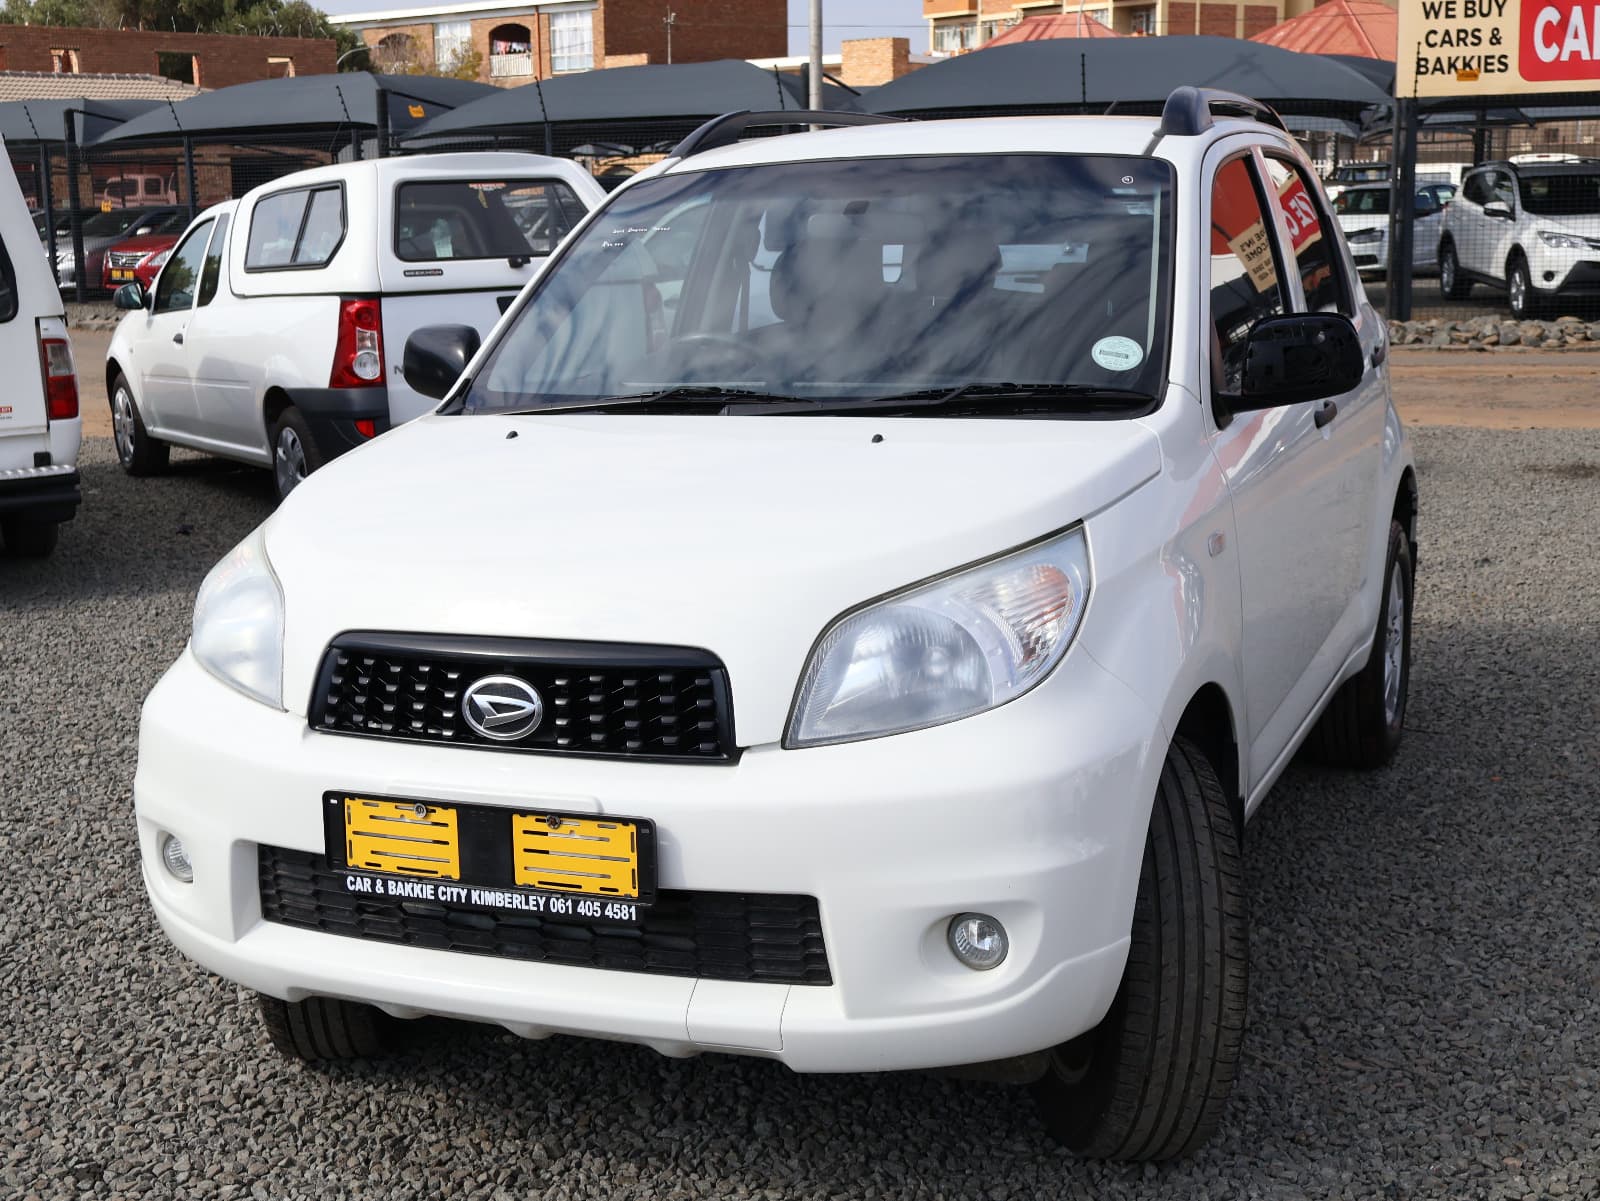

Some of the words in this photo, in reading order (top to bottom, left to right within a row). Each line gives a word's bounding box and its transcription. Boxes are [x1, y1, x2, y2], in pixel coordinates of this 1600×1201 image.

[1422, 0, 1456, 19] WE
[1464, 0, 1506, 18] BUY
[1425, 28, 1482, 48] CARS
[1489, 27, 1502, 46] &
[1533, 5, 1600, 63] CA
[1416, 54, 1509, 75] BAKKIES
[346, 875, 372, 893] CAR
[375, 879, 384, 894] &
[387, 880, 435, 899] BAKKIE
[438, 886, 467, 903] CITY
[471, 890, 546, 912] KIMBERLEY
[550, 898, 573, 914] 061
[577, 901, 601, 917] 405
[605, 903, 636, 921] 4581
